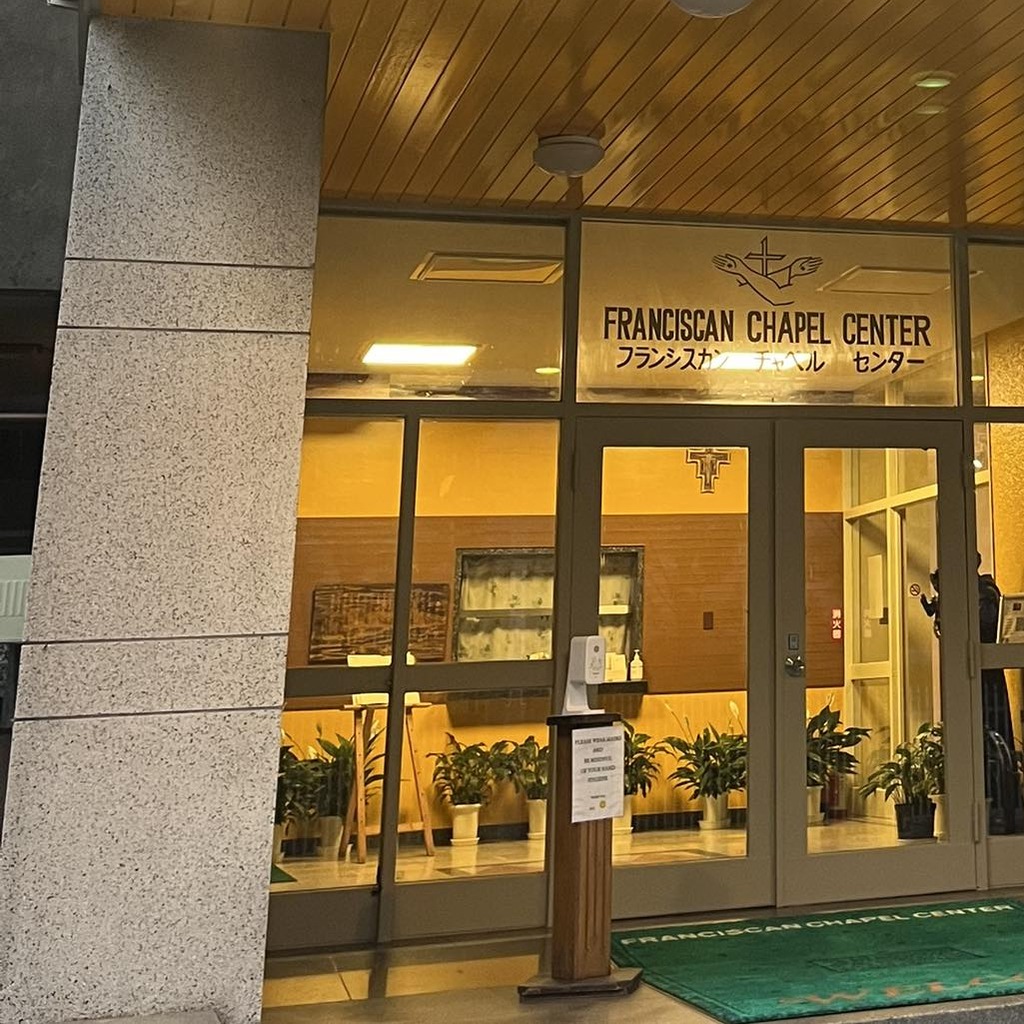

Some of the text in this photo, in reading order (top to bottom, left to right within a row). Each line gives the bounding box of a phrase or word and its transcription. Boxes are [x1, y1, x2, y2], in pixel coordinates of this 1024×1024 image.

[604, 307, 932, 346] FRANCISCAN CHAPEL CENTER
[617, 346, 926, 374] フランシスカン チャペル センター
[621, 904, 1015, 946] FRANCISCAN CHAPEL CENTER
